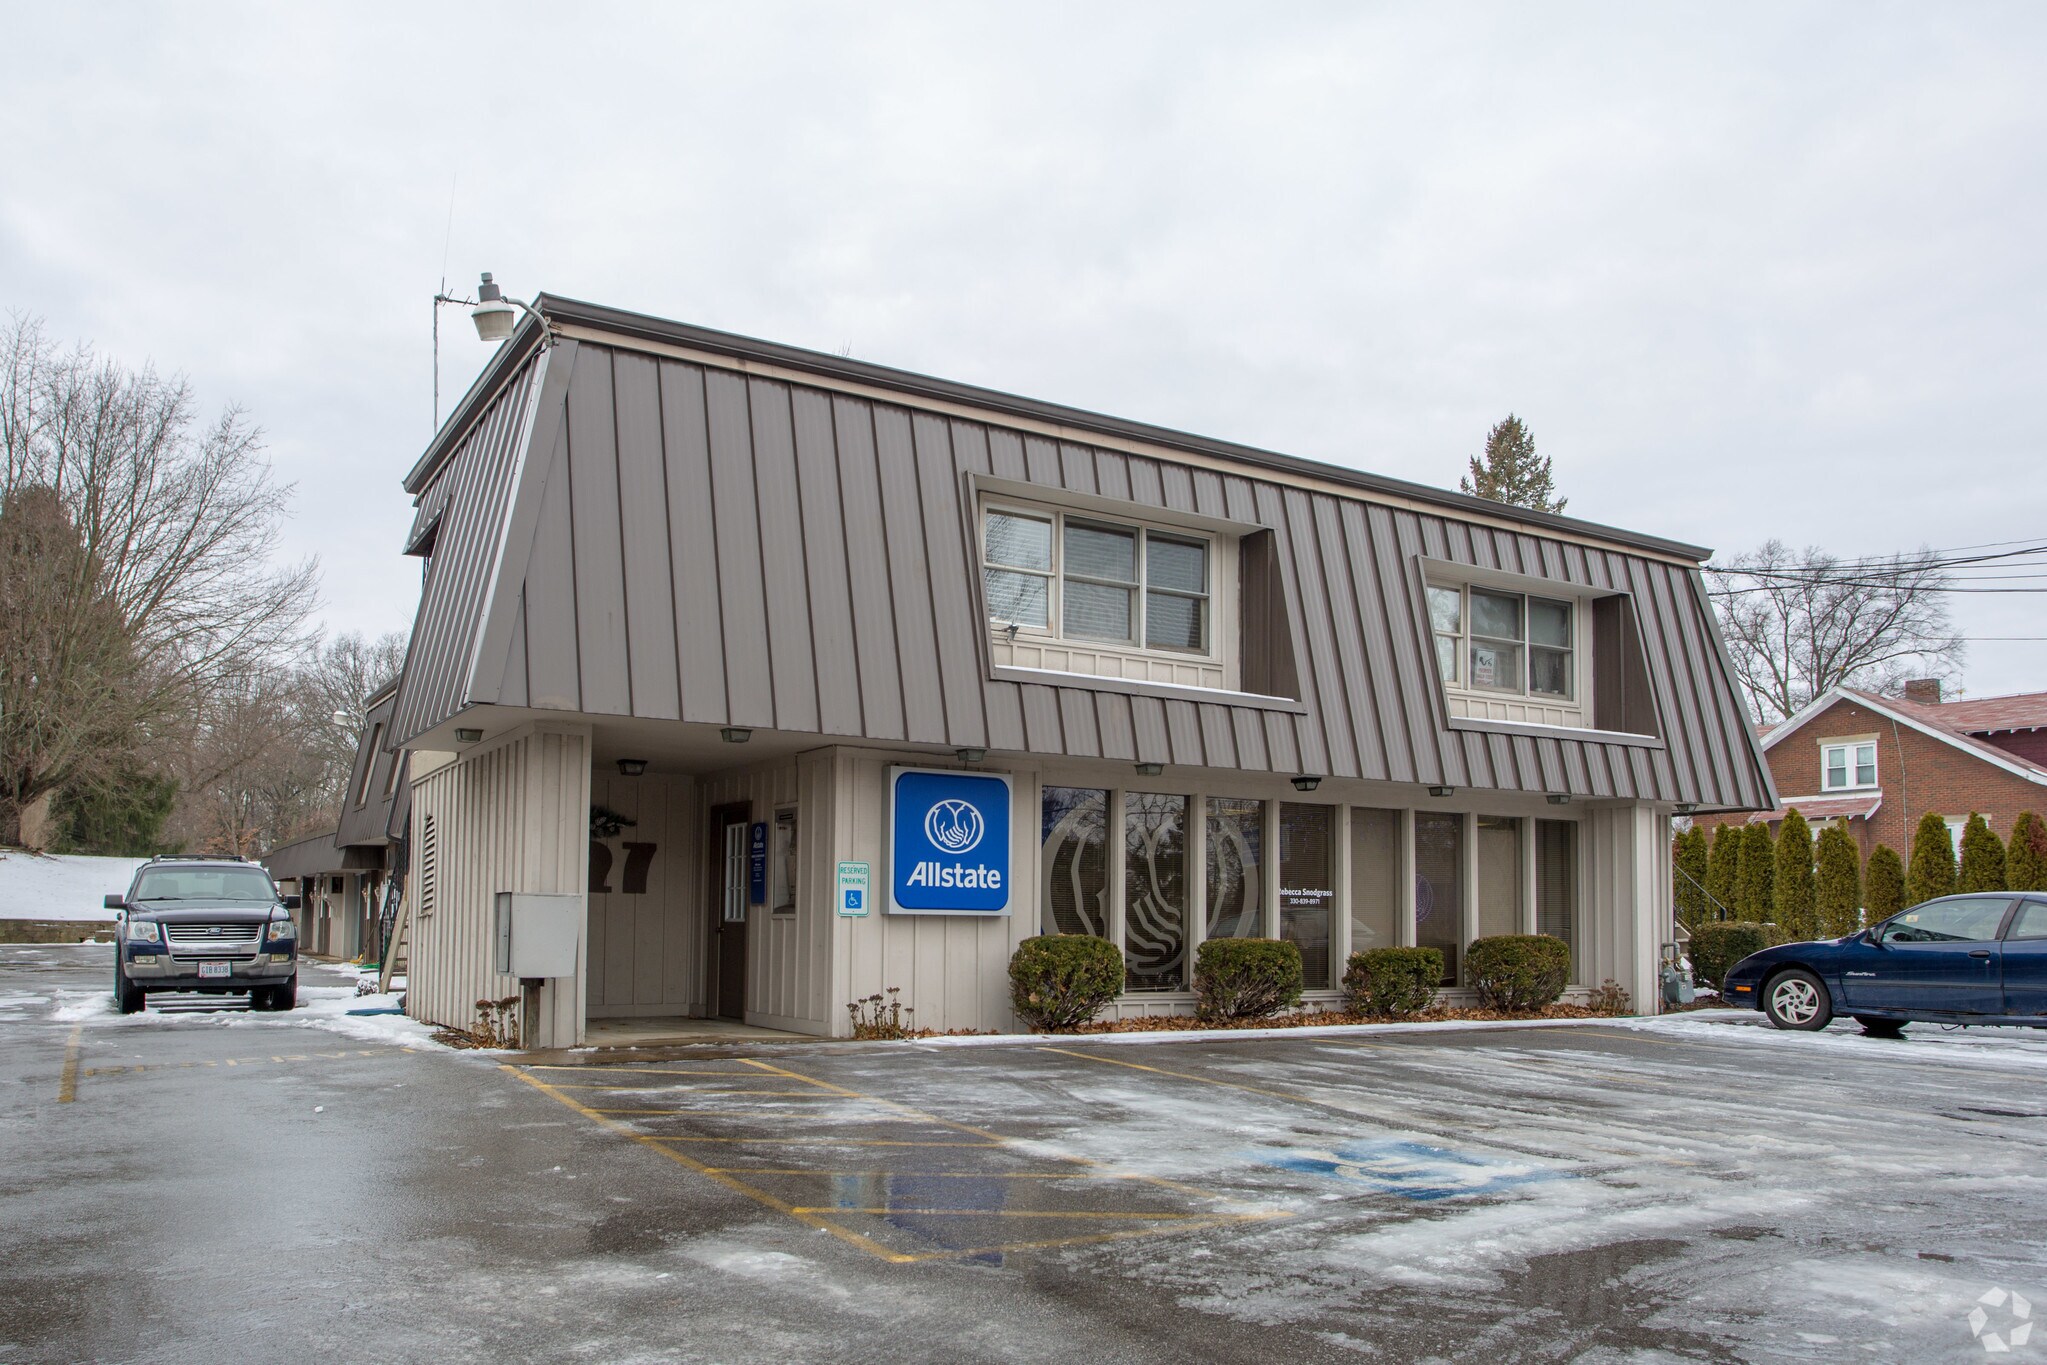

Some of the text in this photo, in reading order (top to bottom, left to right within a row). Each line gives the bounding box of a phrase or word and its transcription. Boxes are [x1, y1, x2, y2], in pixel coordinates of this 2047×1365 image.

[840, 867, 868, 875] RESERVED
[906, 862, 1001, 889] Allstate
[842, 877, 866, 885] PARKING
[1302, 888, 1333, 897] Snodgrass
